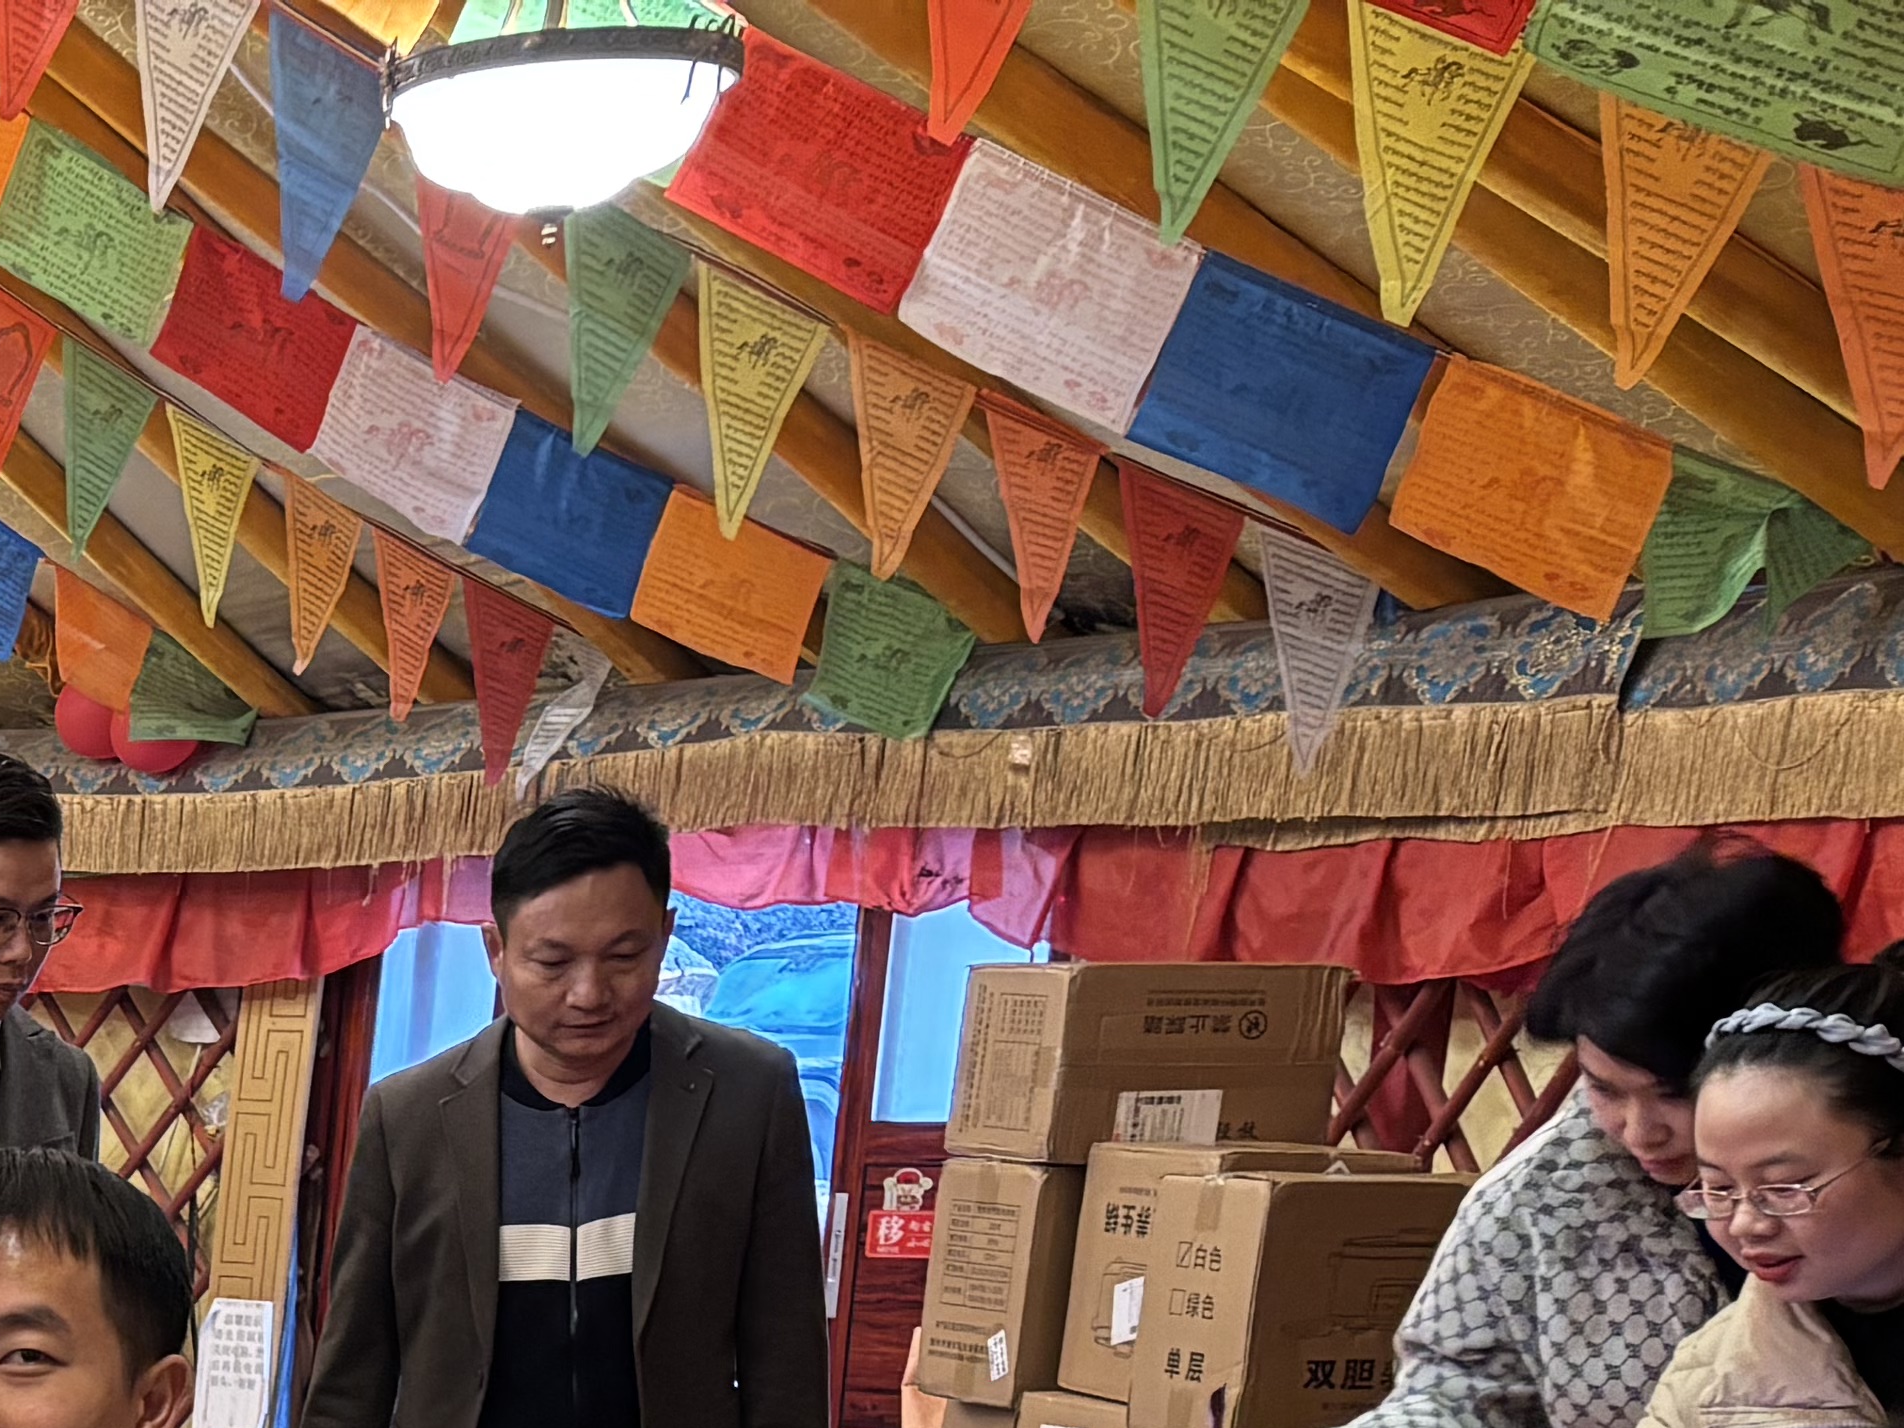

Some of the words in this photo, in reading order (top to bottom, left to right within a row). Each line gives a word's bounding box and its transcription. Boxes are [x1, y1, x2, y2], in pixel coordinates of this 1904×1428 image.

[876, 1215, 905, 1246] 移
[1193, 1244, 1223, 1272] 白色
[1185, 1292, 1215, 1320] 绿色
[1164, 1348, 1205, 1383] 单层
[1303, 1358, 1394, 1391] 双胆
